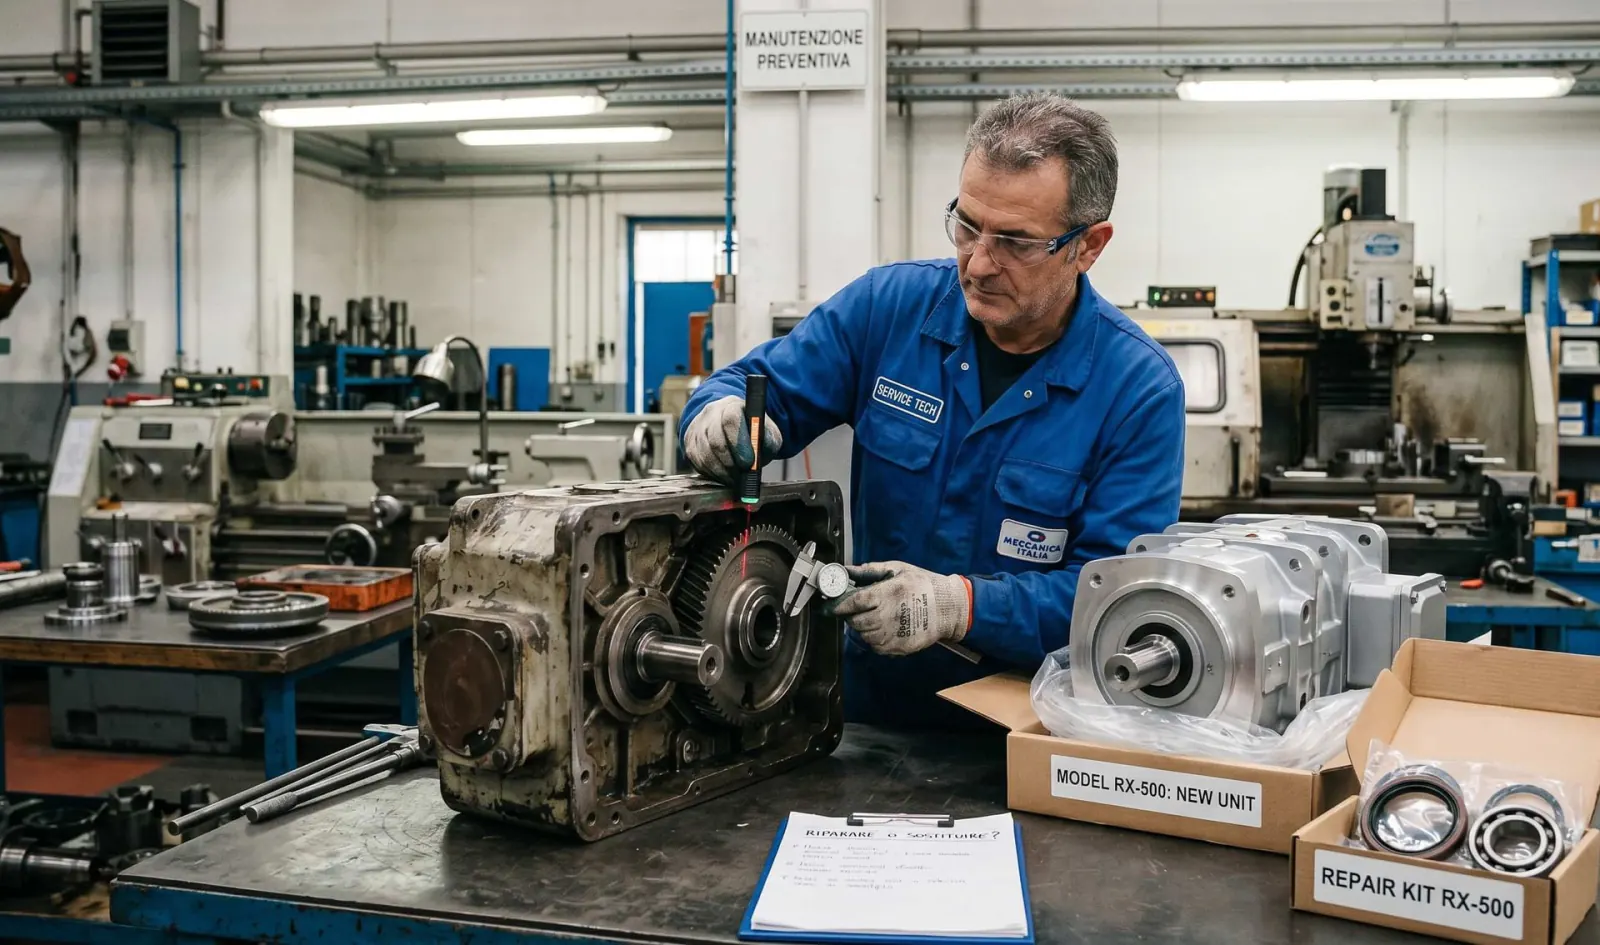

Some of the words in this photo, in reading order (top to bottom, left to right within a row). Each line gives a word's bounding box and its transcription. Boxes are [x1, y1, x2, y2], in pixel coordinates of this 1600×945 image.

[745, 29, 863, 47] MANUTENZIONE
[757, 52, 850, 69] PREVENTIVA
[877, 384, 913, 407] SERVICE
[914, 398, 938, 416] TECH
[1003, 536, 1061, 552] MECCANICA
[1017, 547, 1048, 559] ITALIA
[1056, 768, 1110, 791] MODEL
[1114, 777, 1172, 800] RX-500:
[1176, 786, 1213, 805] NEW
[1218, 792, 1256, 812] UNIT
[1321, 867, 1396, 898] REPAIR
[1402, 881, 1436, 904] KIT
[1441, 888, 1515, 919] RX-500
